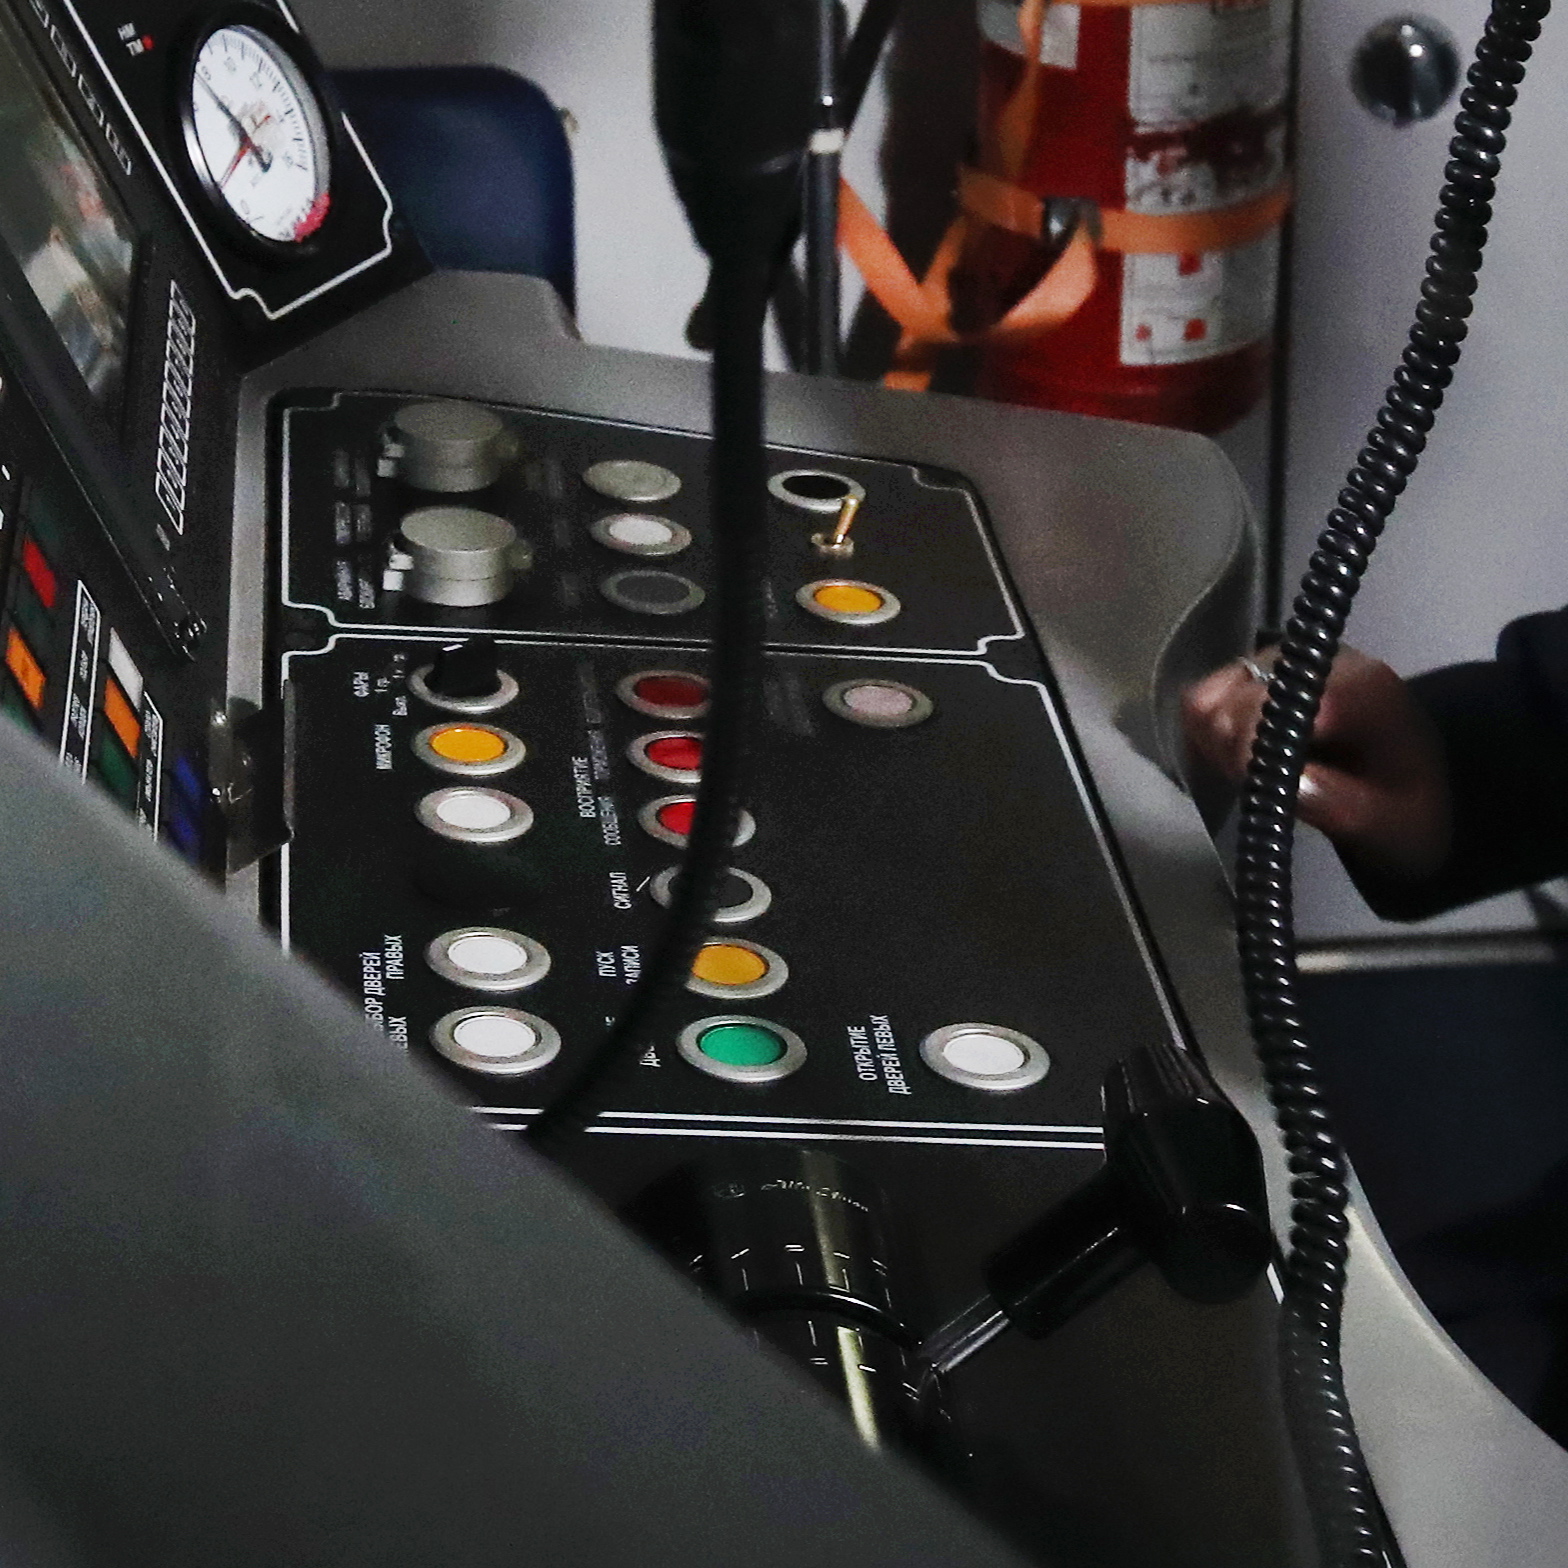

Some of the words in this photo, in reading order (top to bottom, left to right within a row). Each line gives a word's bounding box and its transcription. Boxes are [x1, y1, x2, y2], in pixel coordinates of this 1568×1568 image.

[374, 724, 393, 770] МИКРОФОН
[609, 871, 632, 910] СИГНАЛ
[359, 951, 386, 996] ДВЕРЕЙ
[384, 934, 405, 980] ПРАВЫХ
[595, 950, 617, 977] ПУСК
[364, 997, 384, 1032] БОР
[869, 1014, 897, 1051] ЛЕВЫХ
[388, 1016, 409, 1054] ЕВЫХ
[847, 1025, 878, 1081] ОТКРЫТИЕ
[876, 1053, 912, 1095] ДВЕРЕЙ
